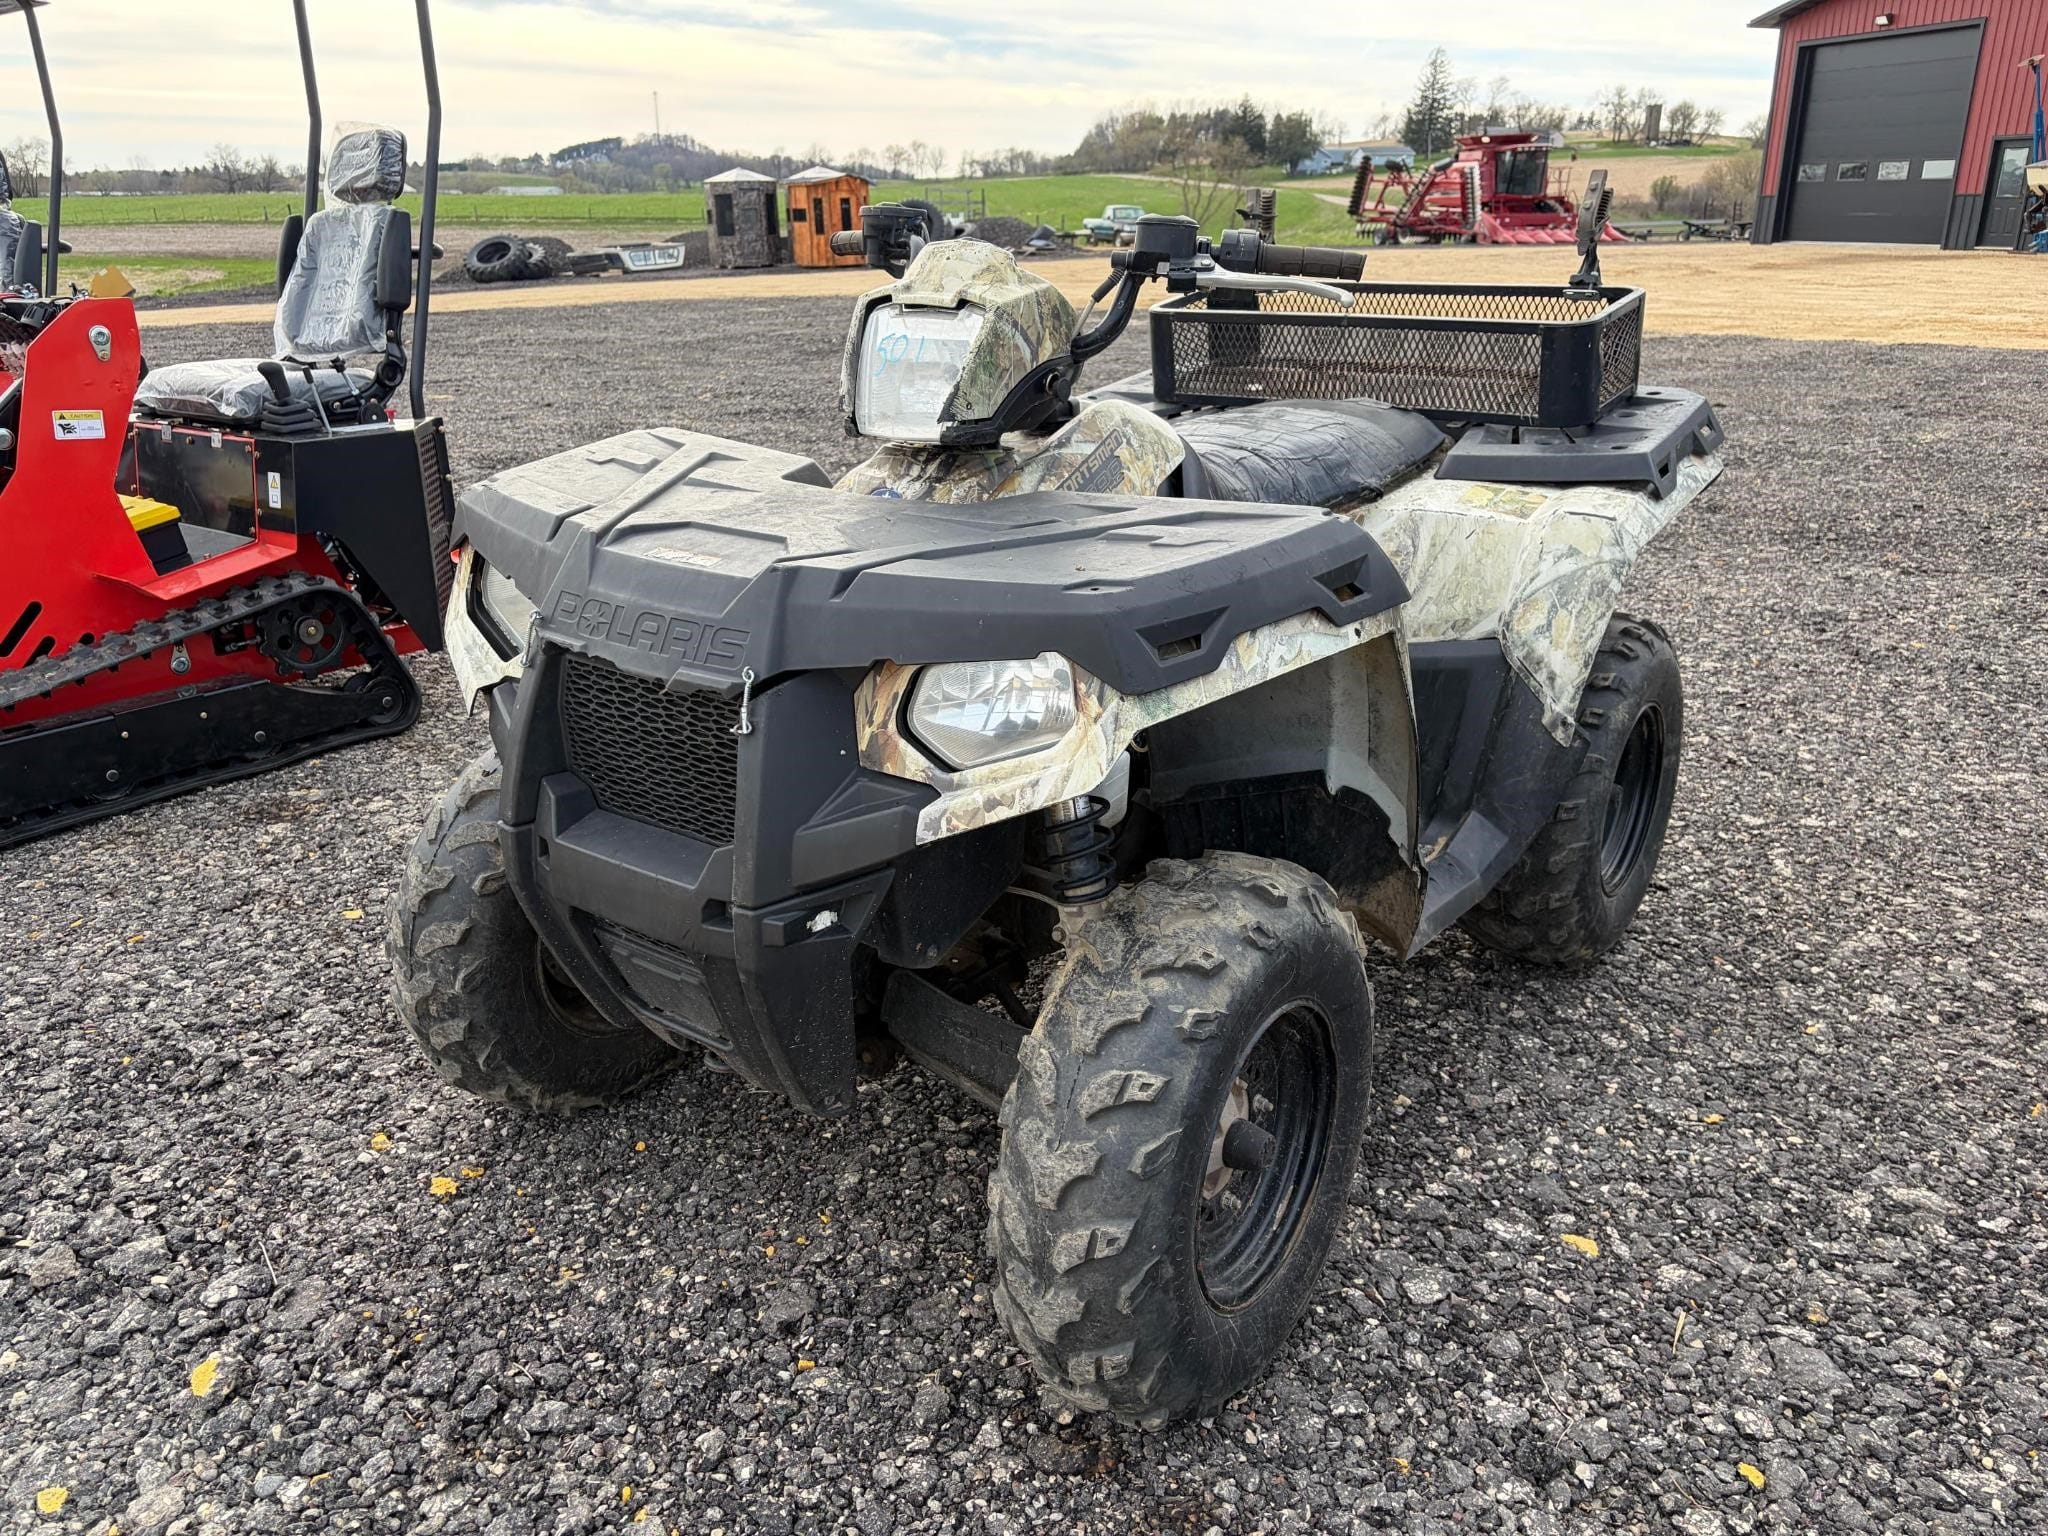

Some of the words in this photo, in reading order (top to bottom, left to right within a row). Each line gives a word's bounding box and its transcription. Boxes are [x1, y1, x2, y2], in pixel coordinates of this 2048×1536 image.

[873, 332, 926, 377] 501
[1059, 428, 1122, 492] ORTSMAN
[549, 589, 751, 671] POLARIS
